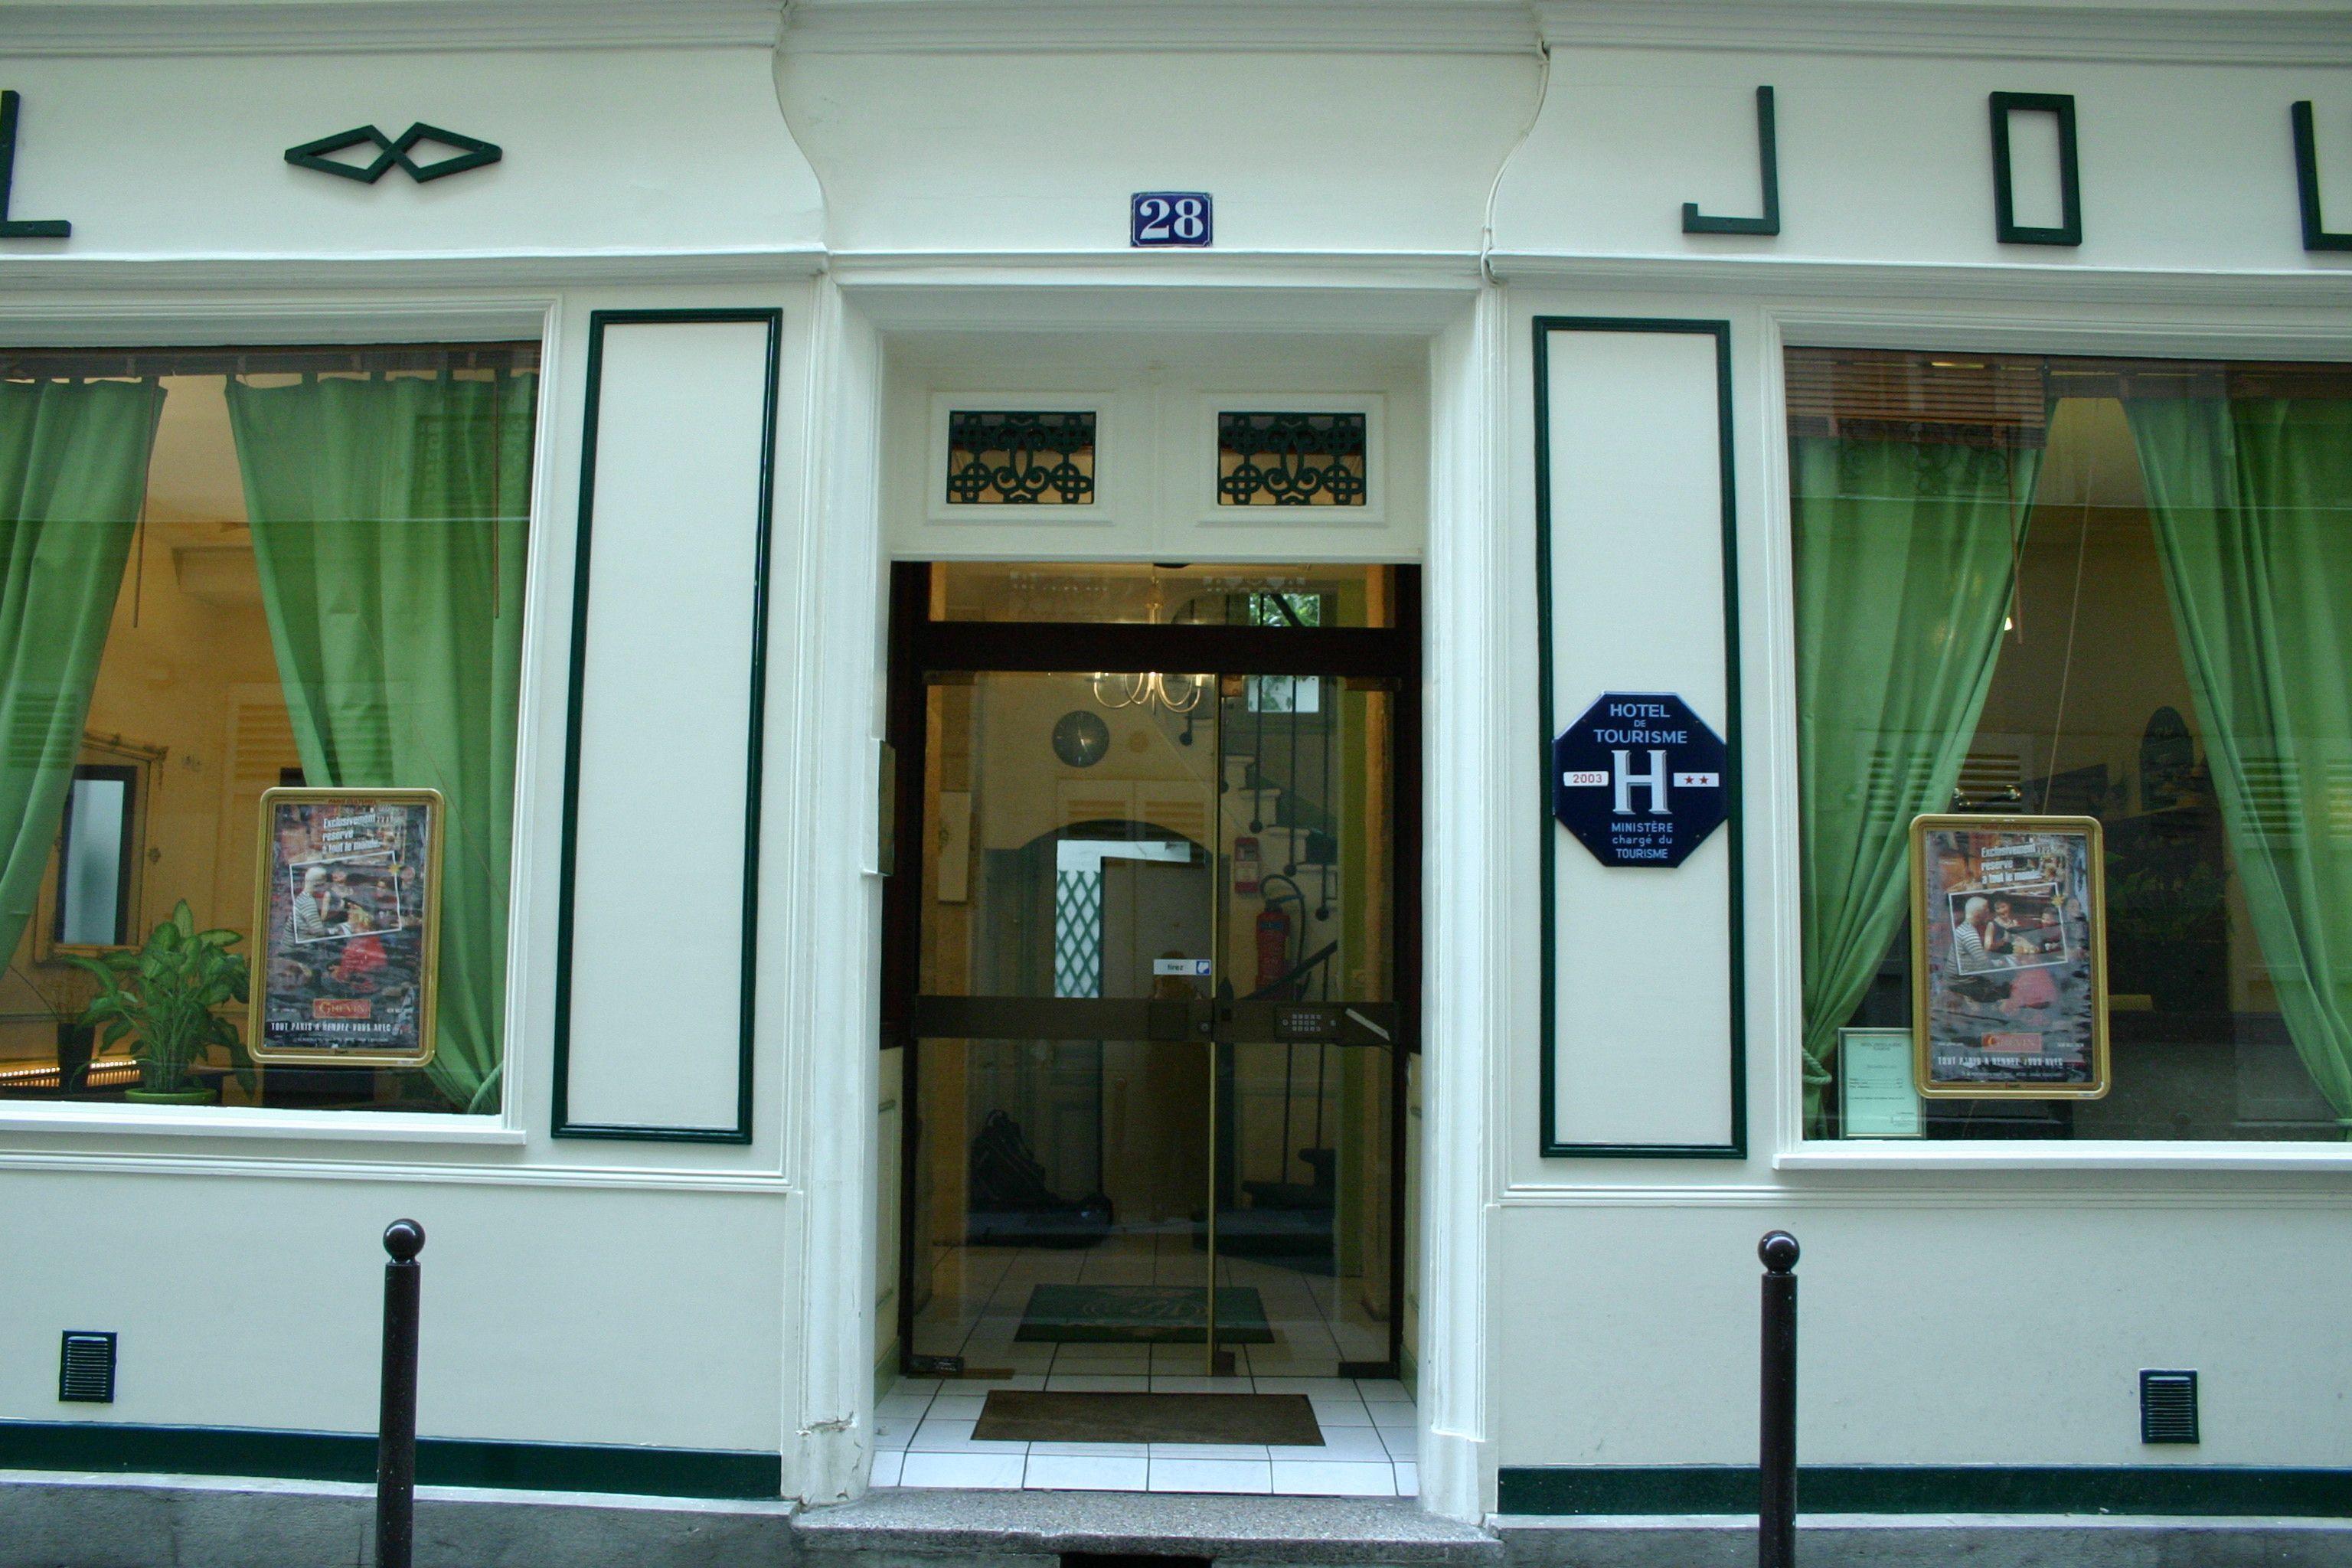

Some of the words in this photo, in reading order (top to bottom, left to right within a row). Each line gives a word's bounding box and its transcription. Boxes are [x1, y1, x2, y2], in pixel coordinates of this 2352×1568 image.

[1139, 198, 1204, 240] 28
[1610, 703, 1671, 718] HOTEL
[1633, 720, 1647, 728] DE
[1593, 729, 1688, 744] TOURISME
[1572, 773, 1602, 784] 2003
[1611, 750, 1673, 815] H
[323, 813, 376, 829] Exclusivement
[1611, 821, 1674, 833] MINISTÈRE
[1612, 835, 1652, 847] chargé
[1658, 835, 1673, 844] du
[1615, 848, 1668, 859] TOURISME
[271, 1022, 289, 1031] TOUT
[291, 1022, 312, 1032] PARIS
[374, 1023, 392, 1032] AVEC
[1939, 1057, 1955, 1066] TOUT
